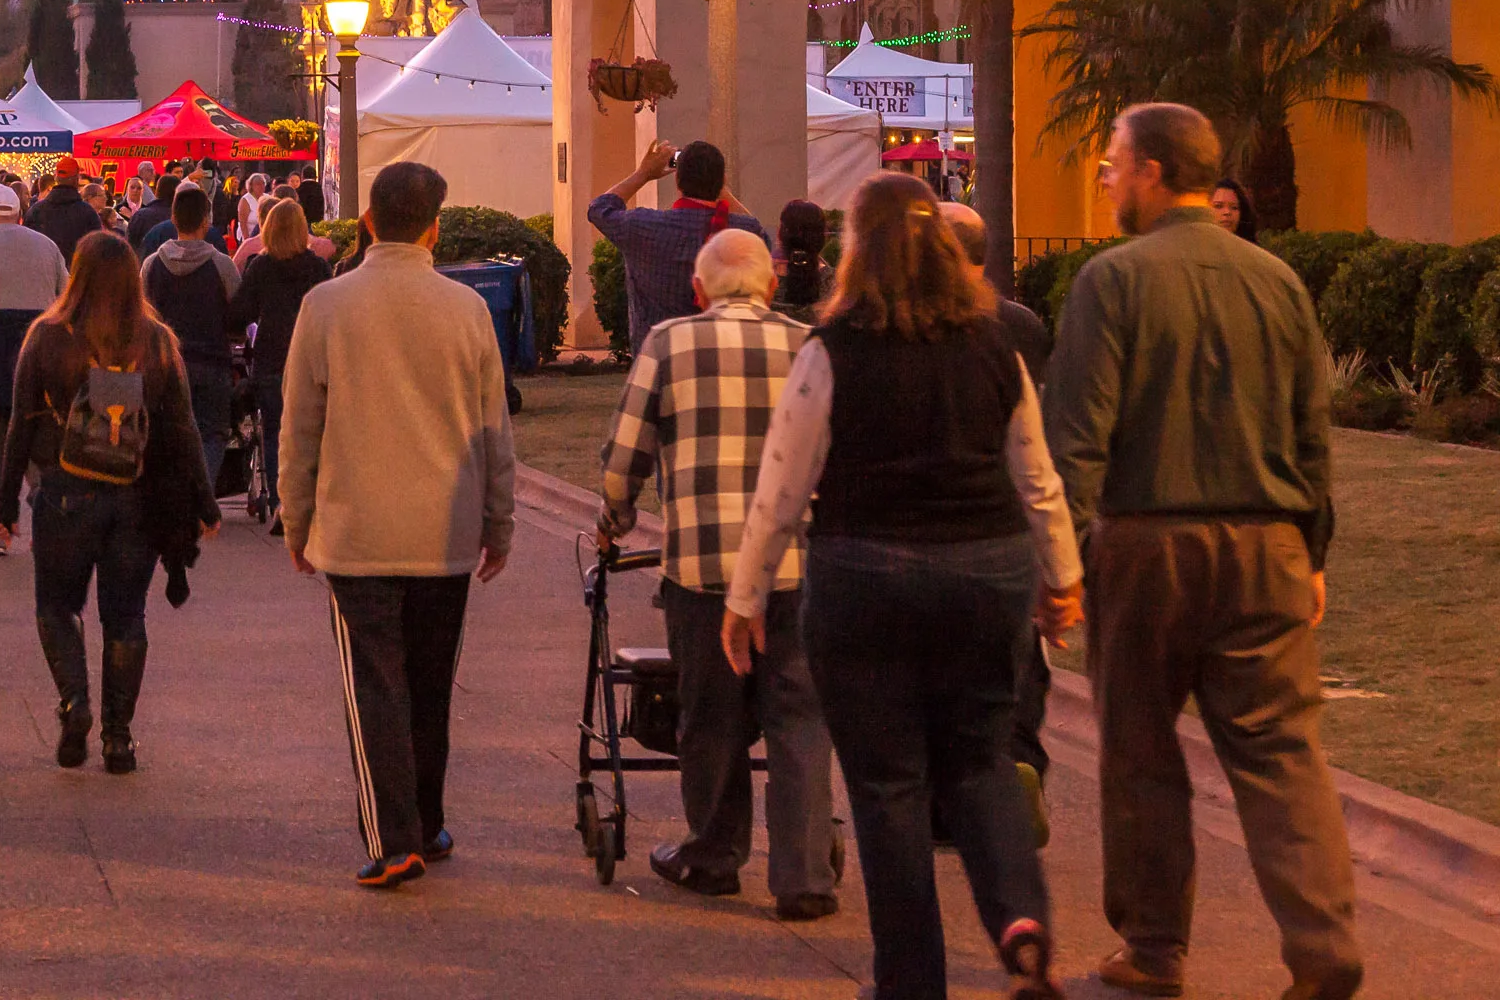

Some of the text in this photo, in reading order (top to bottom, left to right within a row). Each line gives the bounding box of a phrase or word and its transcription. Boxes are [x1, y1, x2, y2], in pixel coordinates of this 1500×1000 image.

[853, 81, 916, 97] ENTER
[859, 98, 909, 113] HERE
[91, 139, 168, 158] 5-hour ENERGY
[231, 139, 260, 158] 5-hour
